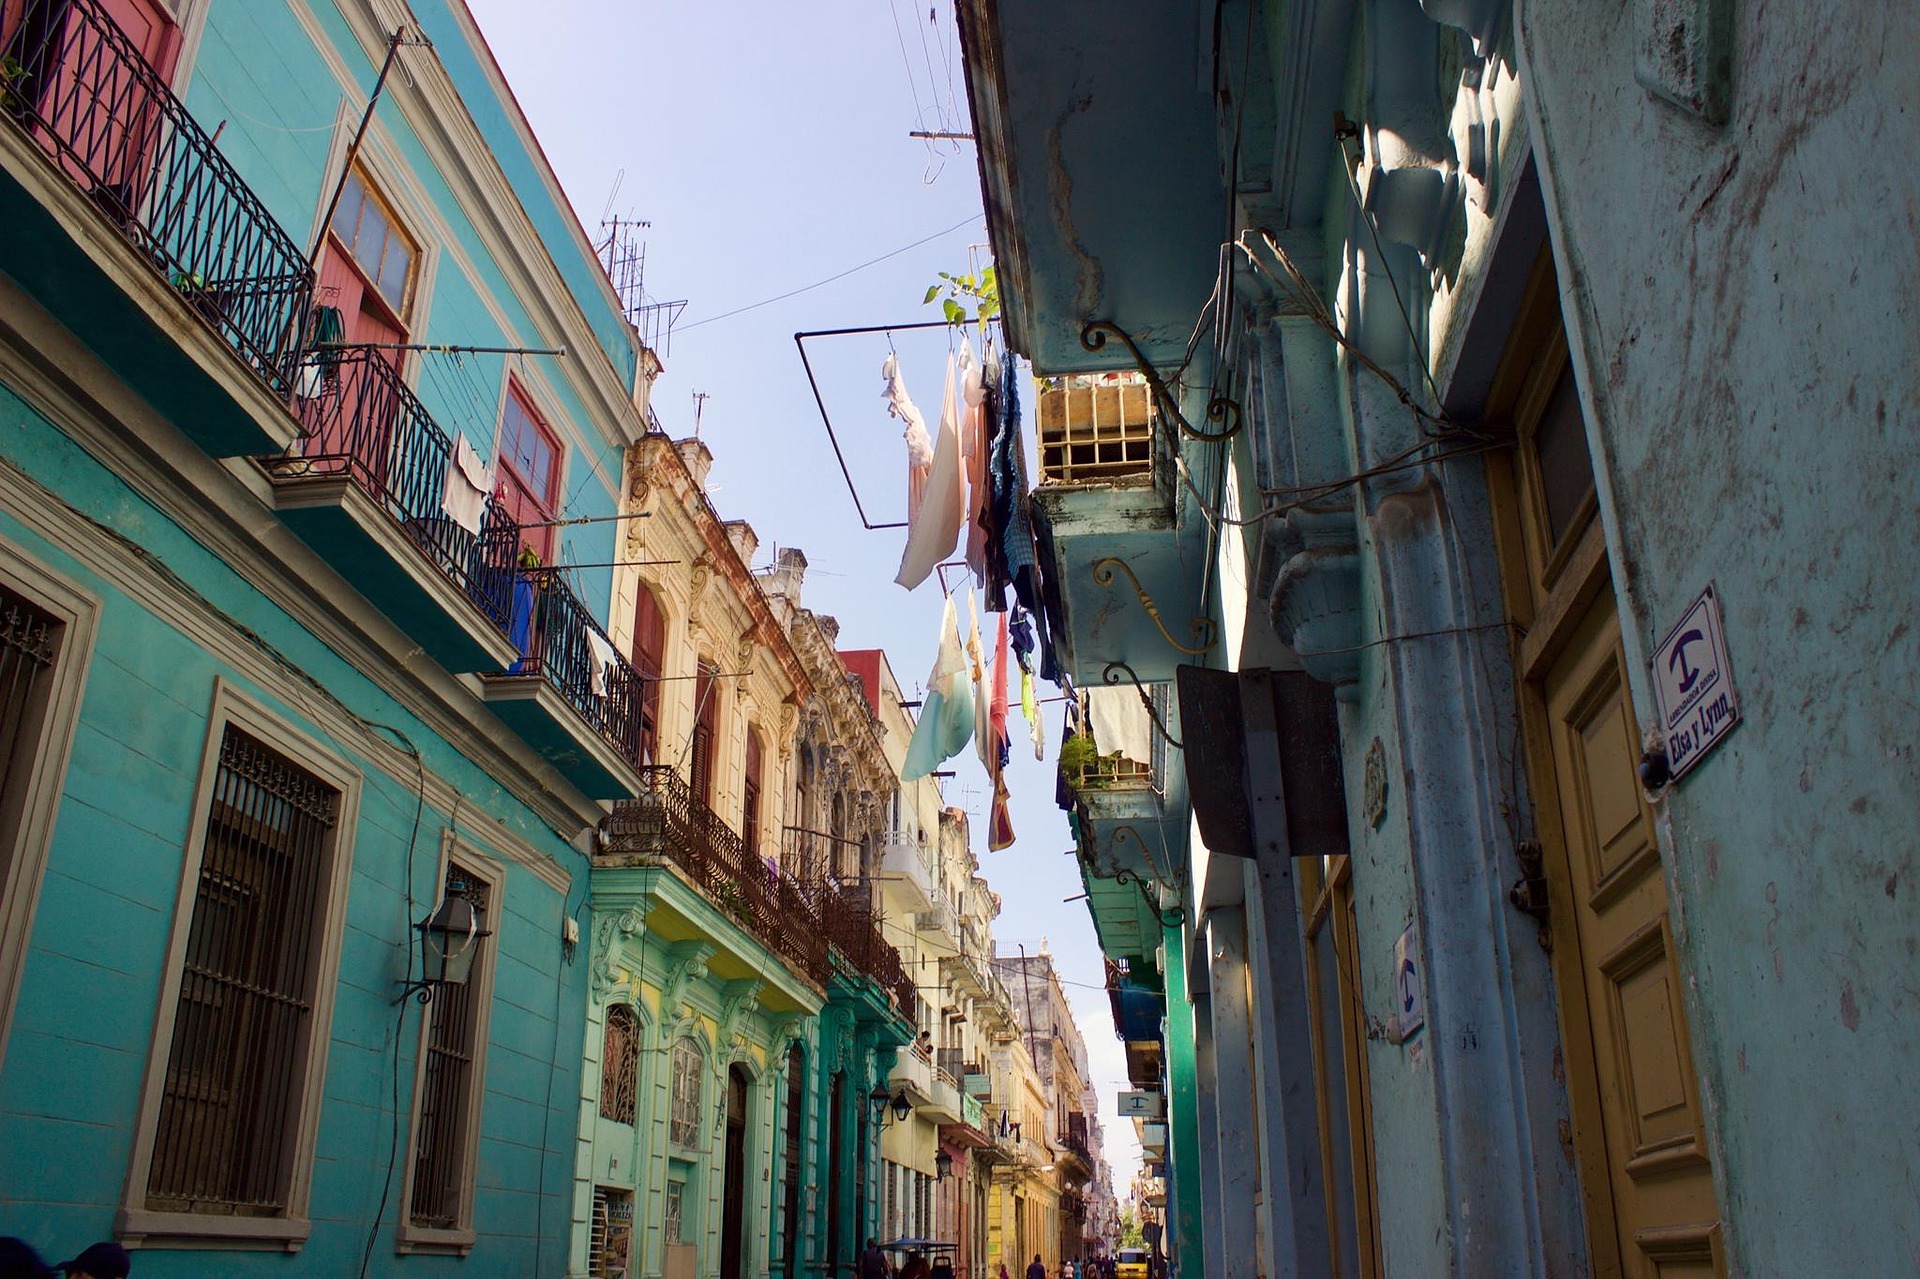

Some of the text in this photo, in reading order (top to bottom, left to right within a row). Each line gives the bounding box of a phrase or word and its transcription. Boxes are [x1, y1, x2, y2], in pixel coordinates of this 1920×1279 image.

[1669, 668, 1717, 722] ARRENDADOR DIVISA
[1669, 692, 1729, 765] Elsa y Lynn
